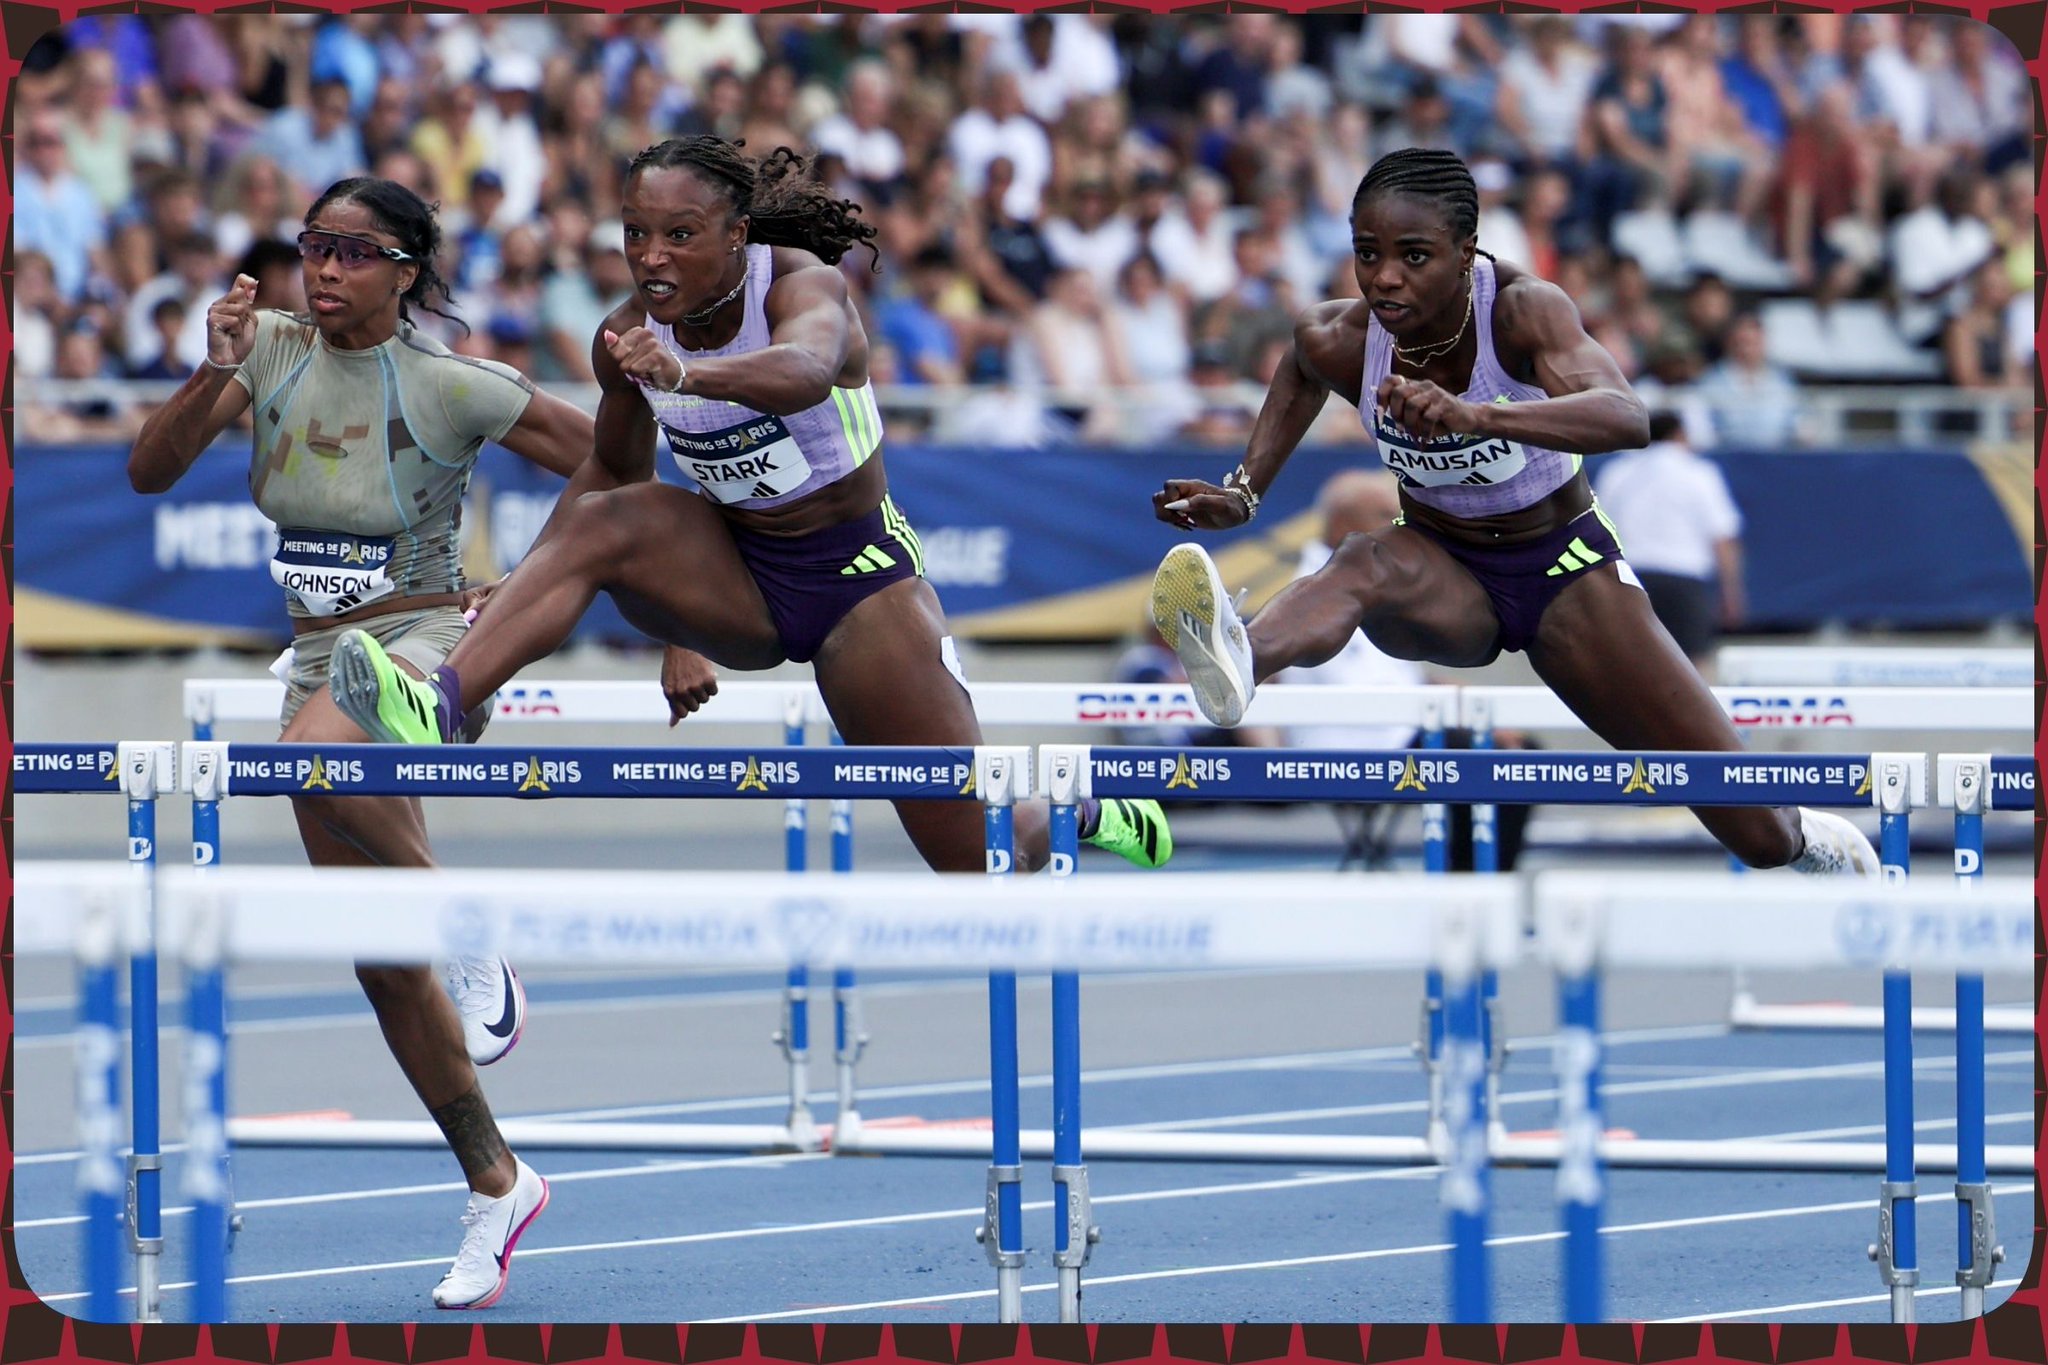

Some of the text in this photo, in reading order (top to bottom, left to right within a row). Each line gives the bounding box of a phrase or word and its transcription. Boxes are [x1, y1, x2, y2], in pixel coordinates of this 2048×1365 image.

[668, 421, 778, 451] MEETING DE PARIS
[692, 451, 779, 482] STARK
[1388, 439, 1512, 471] AMUSAN
[283, 540, 388, 564] MEETING DE PARIS
[282, 571, 371, 595] JOHNSON
[77, 754, 95, 770] DE
[275, 762, 293, 778] DE
[296, 754, 364, 790] PARIS
[396, 756, 582, 791] MEETING DE PARIS
[612, 756, 800, 791] MEETING DE PARIS
[834, 765, 926, 783] MEETING
[931, 766, 950, 783] DE
[1137, 761, 1156, 778] DE
[1160, 752, 1231, 789] PARIS
[1266, 755, 1460, 791] MEETING DE PARIS
[1493, 756, 1690, 794] MEETING DE PARIS
[1723, 766, 1820, 785] MEETING
[1825, 767, 1844, 784] DE
